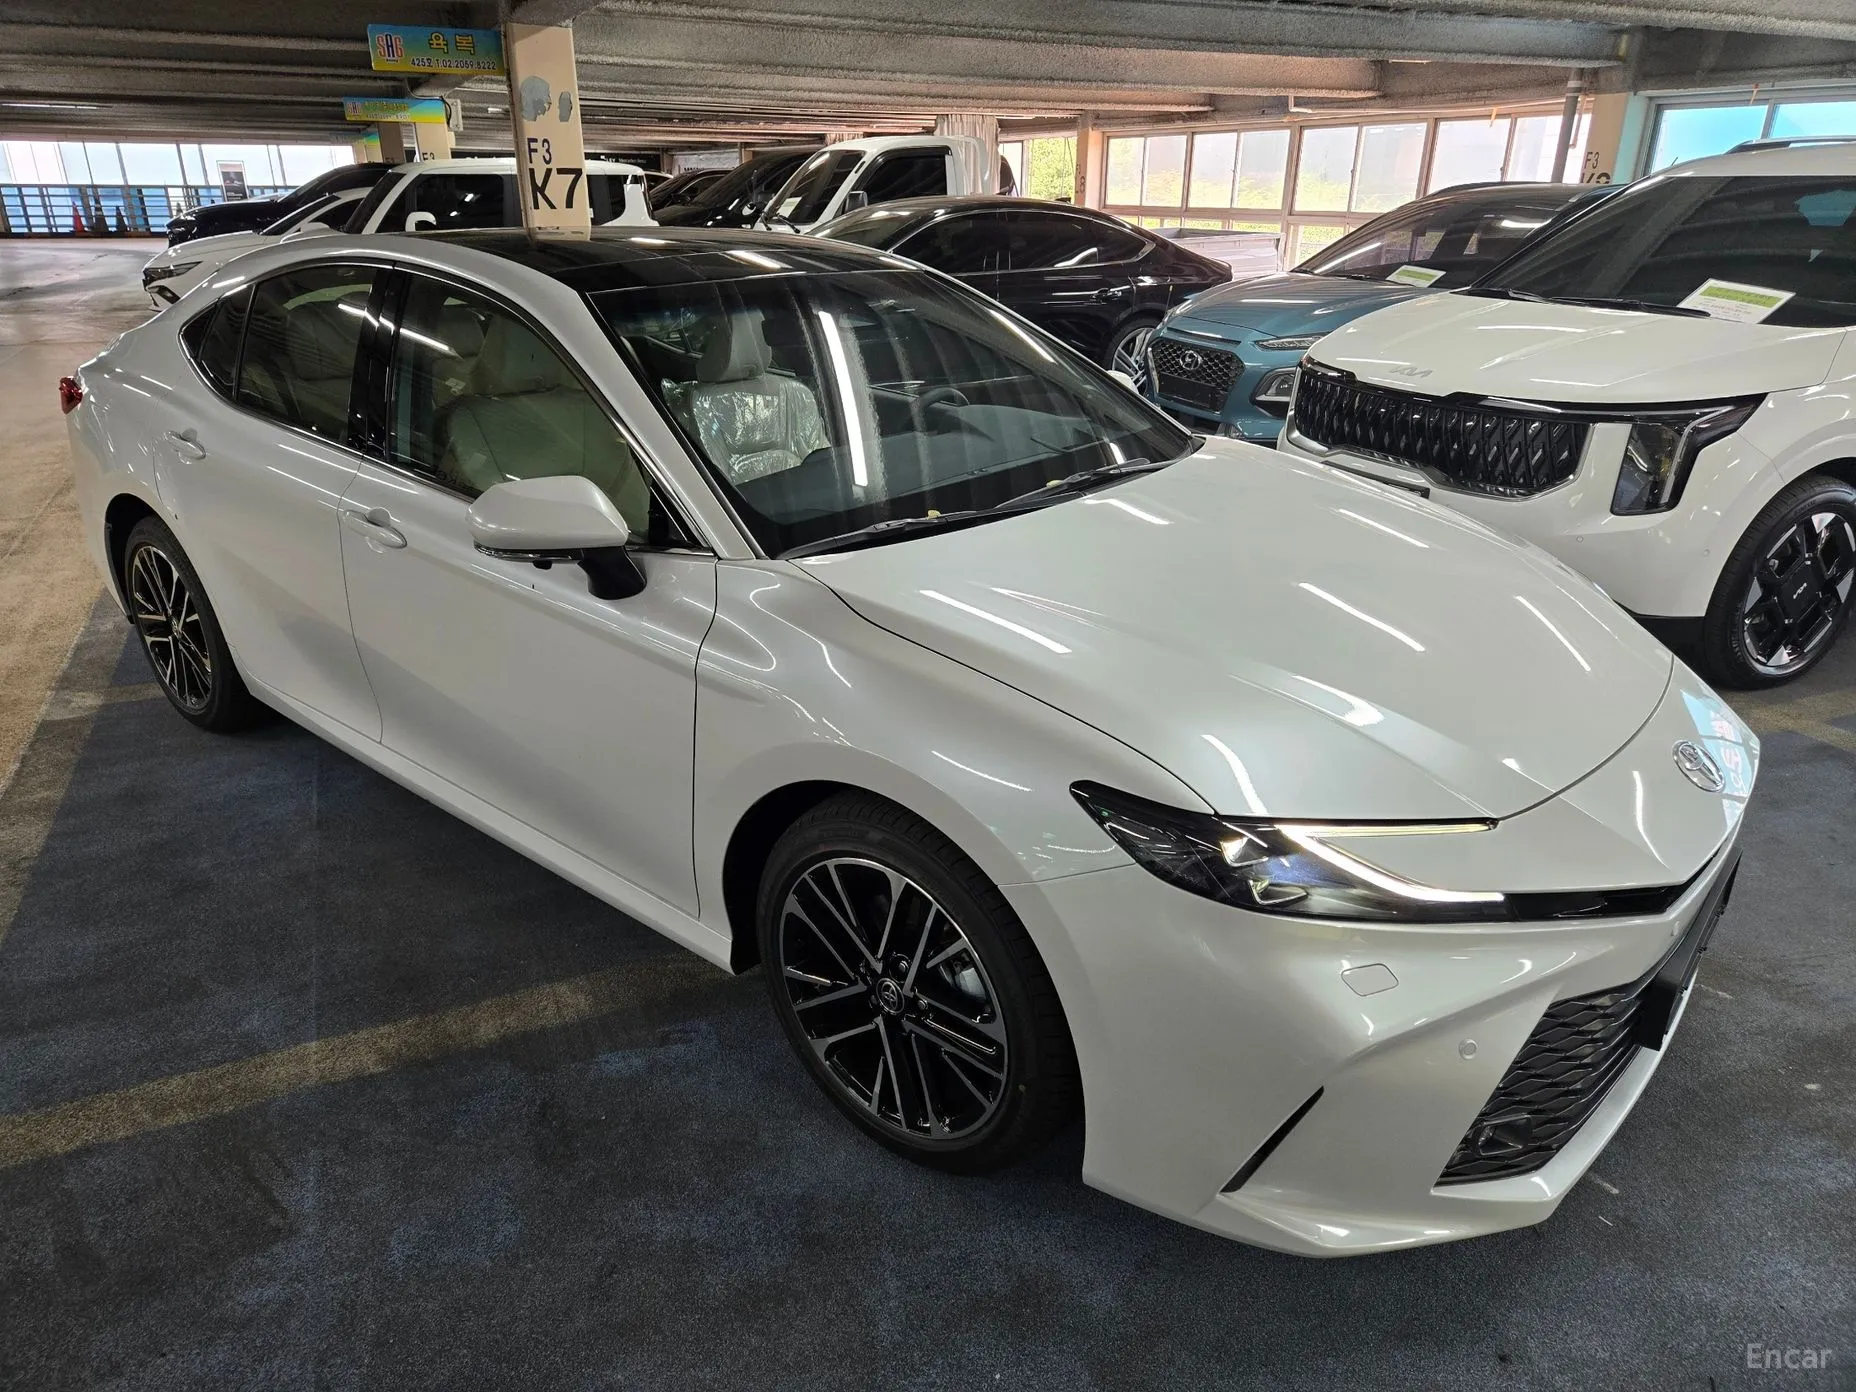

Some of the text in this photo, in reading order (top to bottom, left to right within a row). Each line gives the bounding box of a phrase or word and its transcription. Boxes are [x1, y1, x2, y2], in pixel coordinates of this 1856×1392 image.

[527, 137, 552, 165] F3
[1584, 151, 1599, 169] F3
[529, 168, 583, 209] K7
